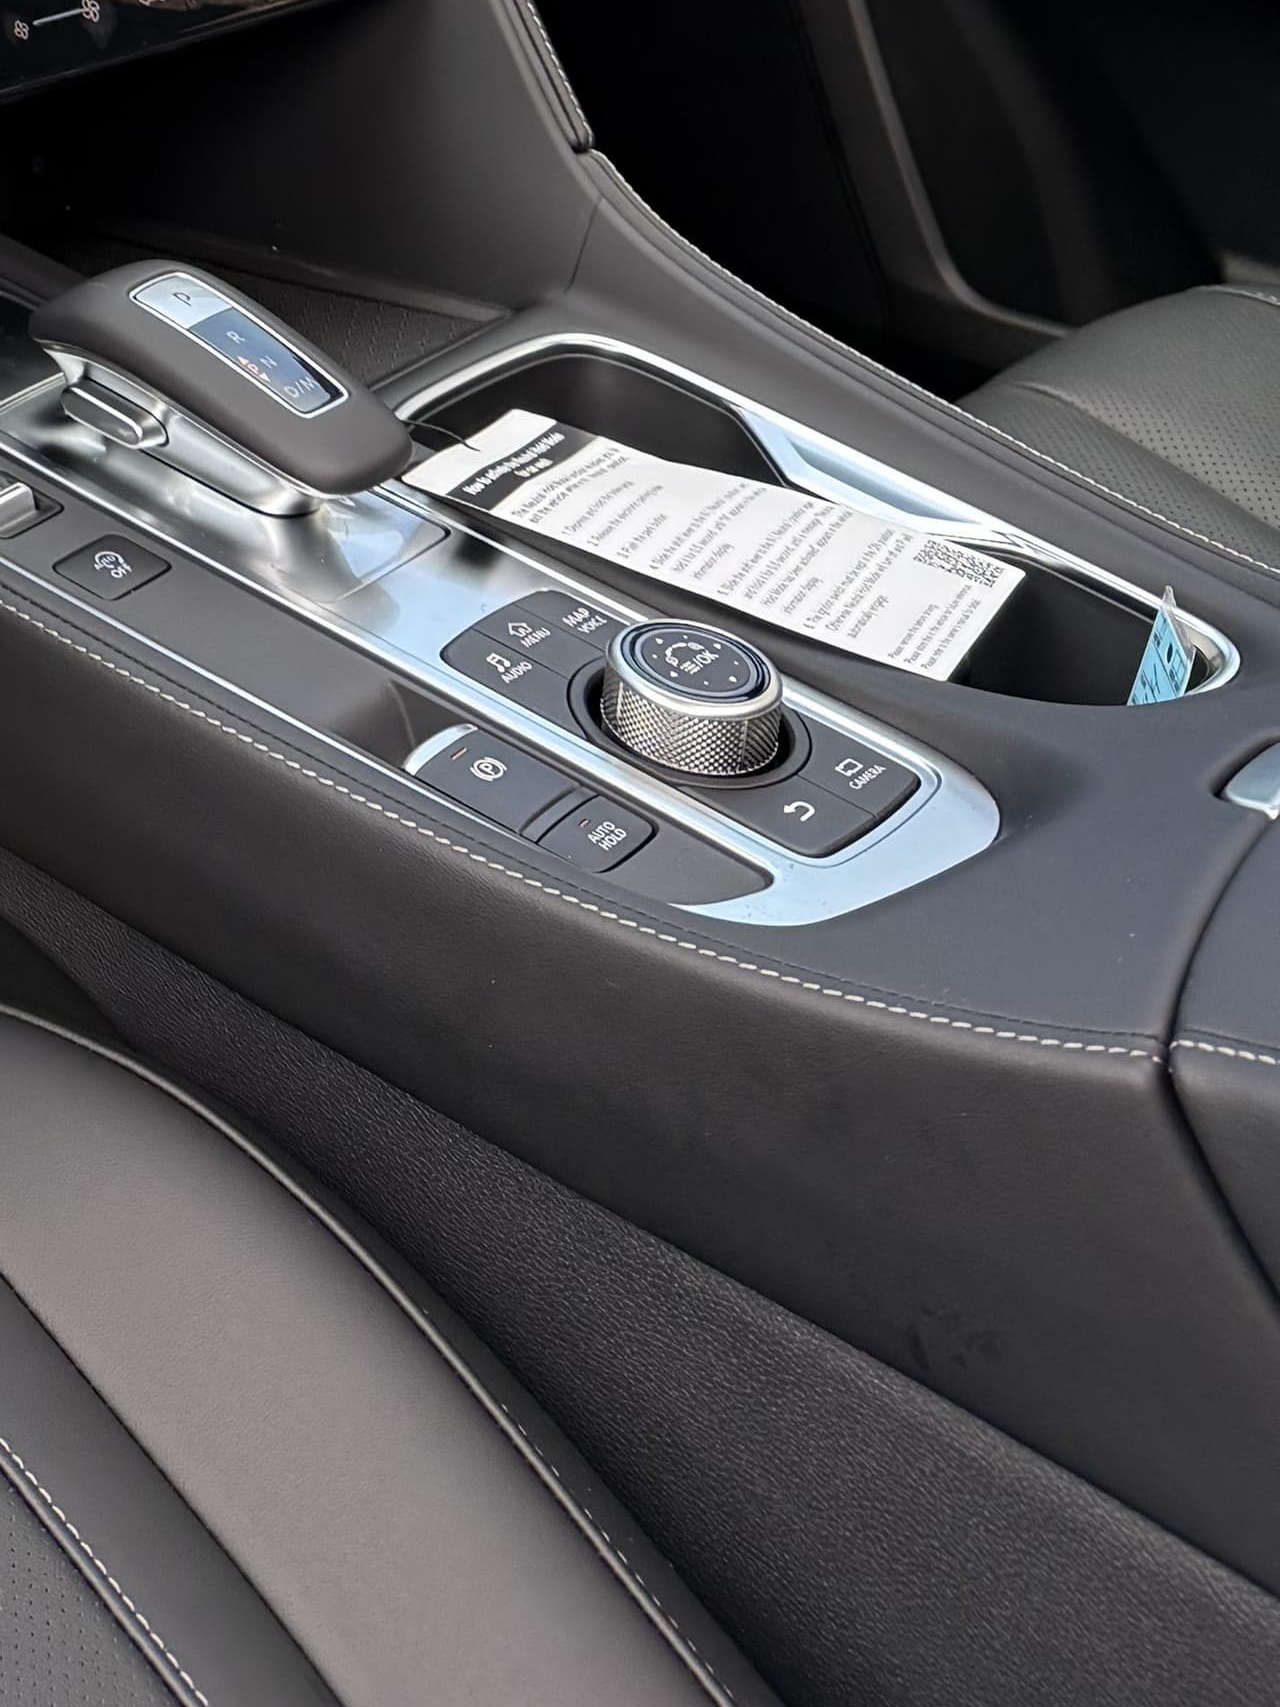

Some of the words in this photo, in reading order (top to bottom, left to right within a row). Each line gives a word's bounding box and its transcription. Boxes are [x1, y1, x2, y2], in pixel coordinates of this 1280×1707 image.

[173, 292, 192, 307] P
[226, 331, 245, 344] R
[260, 356, 278, 370] N
[284, 375, 317, 398] D/M
[562, 607, 590, 628] MAP
[578, 615, 608, 635] VOICE
[520, 627, 551, 649] MENU
[501, 661, 533, 684] AUDIO
[849, 764, 886, 790] CAMERA
[586, 820, 617, 843] AUTO
[597, 827, 627, 851] HOLD
